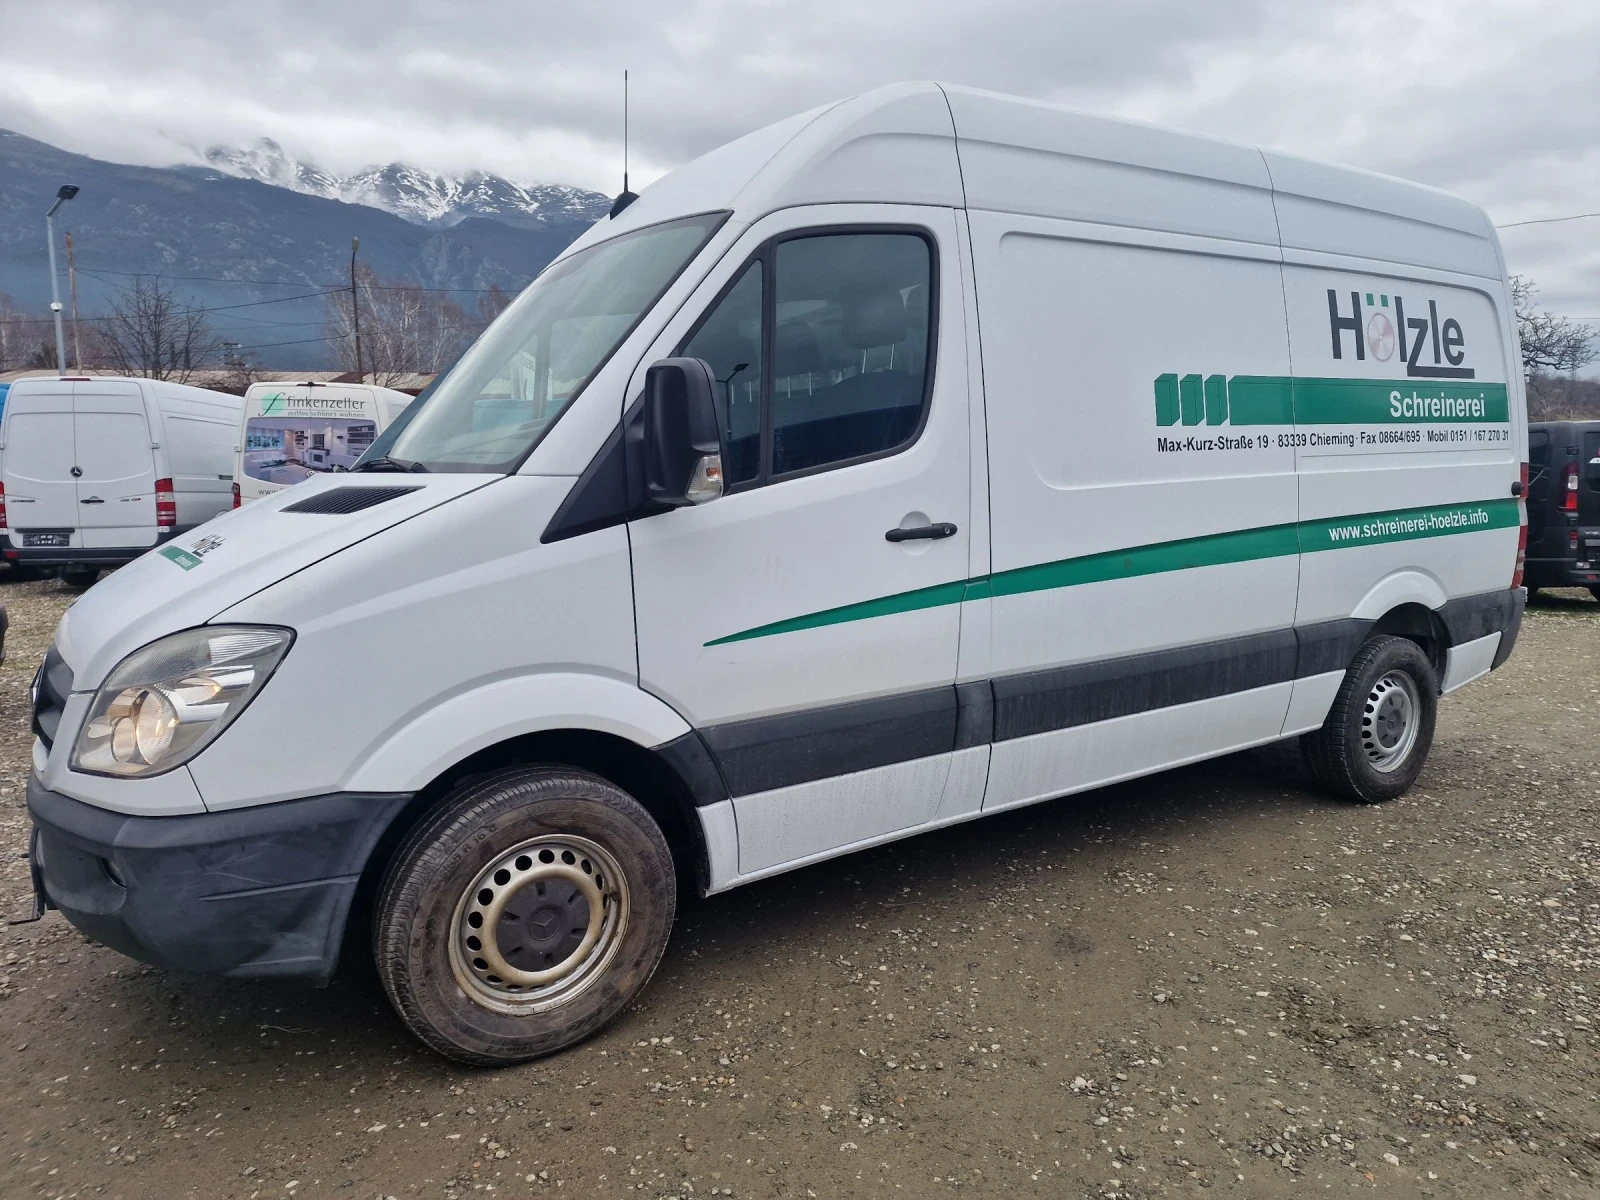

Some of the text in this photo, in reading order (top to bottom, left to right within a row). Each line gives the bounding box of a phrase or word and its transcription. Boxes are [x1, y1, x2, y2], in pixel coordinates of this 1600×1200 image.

[287, 396, 365, 409] finkenzeller
[1390, 390, 1485, 417] Schreinerei
[1157, 436, 1253, 452] Max-Kurz-Straße
[1257, 435, 1269, 448] 19
[1278, 432, 1307, 447] 83339
[1310, 430, 1354, 447] Chieming
[1360, 432, 1377, 444] Fax
[1379, 430, 1421, 443] 08664/695
[1427, 430, 1449, 442] Mobil
[1450, 430, 1468, 441] 0151
[1474, 430, 1486, 441] 167
[1488, 430, 1500, 441] 270
[1502, 430, 1509, 441] 31
[1329, 509, 1489, 541] www.schreinerei-hoelzle.info
